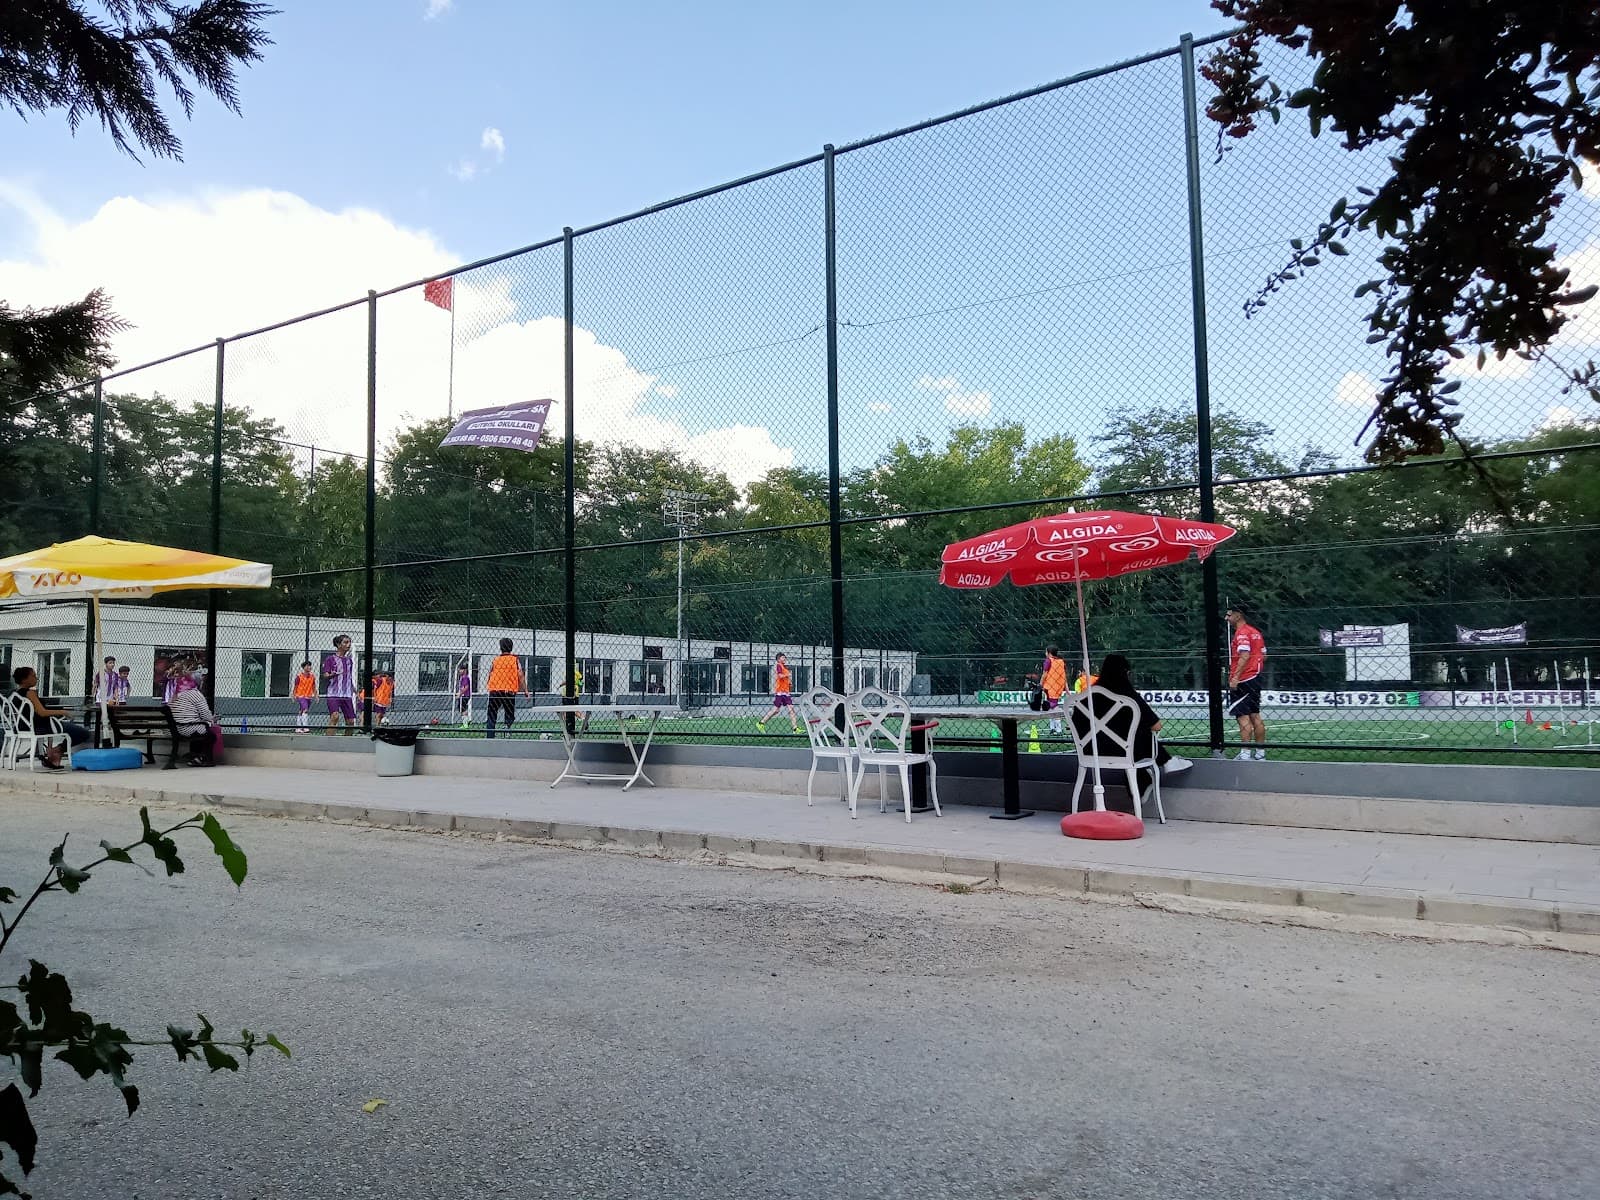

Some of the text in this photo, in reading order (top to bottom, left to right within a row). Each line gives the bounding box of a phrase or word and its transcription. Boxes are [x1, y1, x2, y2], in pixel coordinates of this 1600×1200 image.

[497, 421, 536, 431] OKULLARI
[480, 434, 498, 443] 0506
[1144, 691, 1183, 703] 0546
[1187, 691, 1209, 703] 43
[1278, 692, 1319, 704] 0312
[1358, 692, 1380, 704] 92
[1385, 692, 1408, 704] 02
